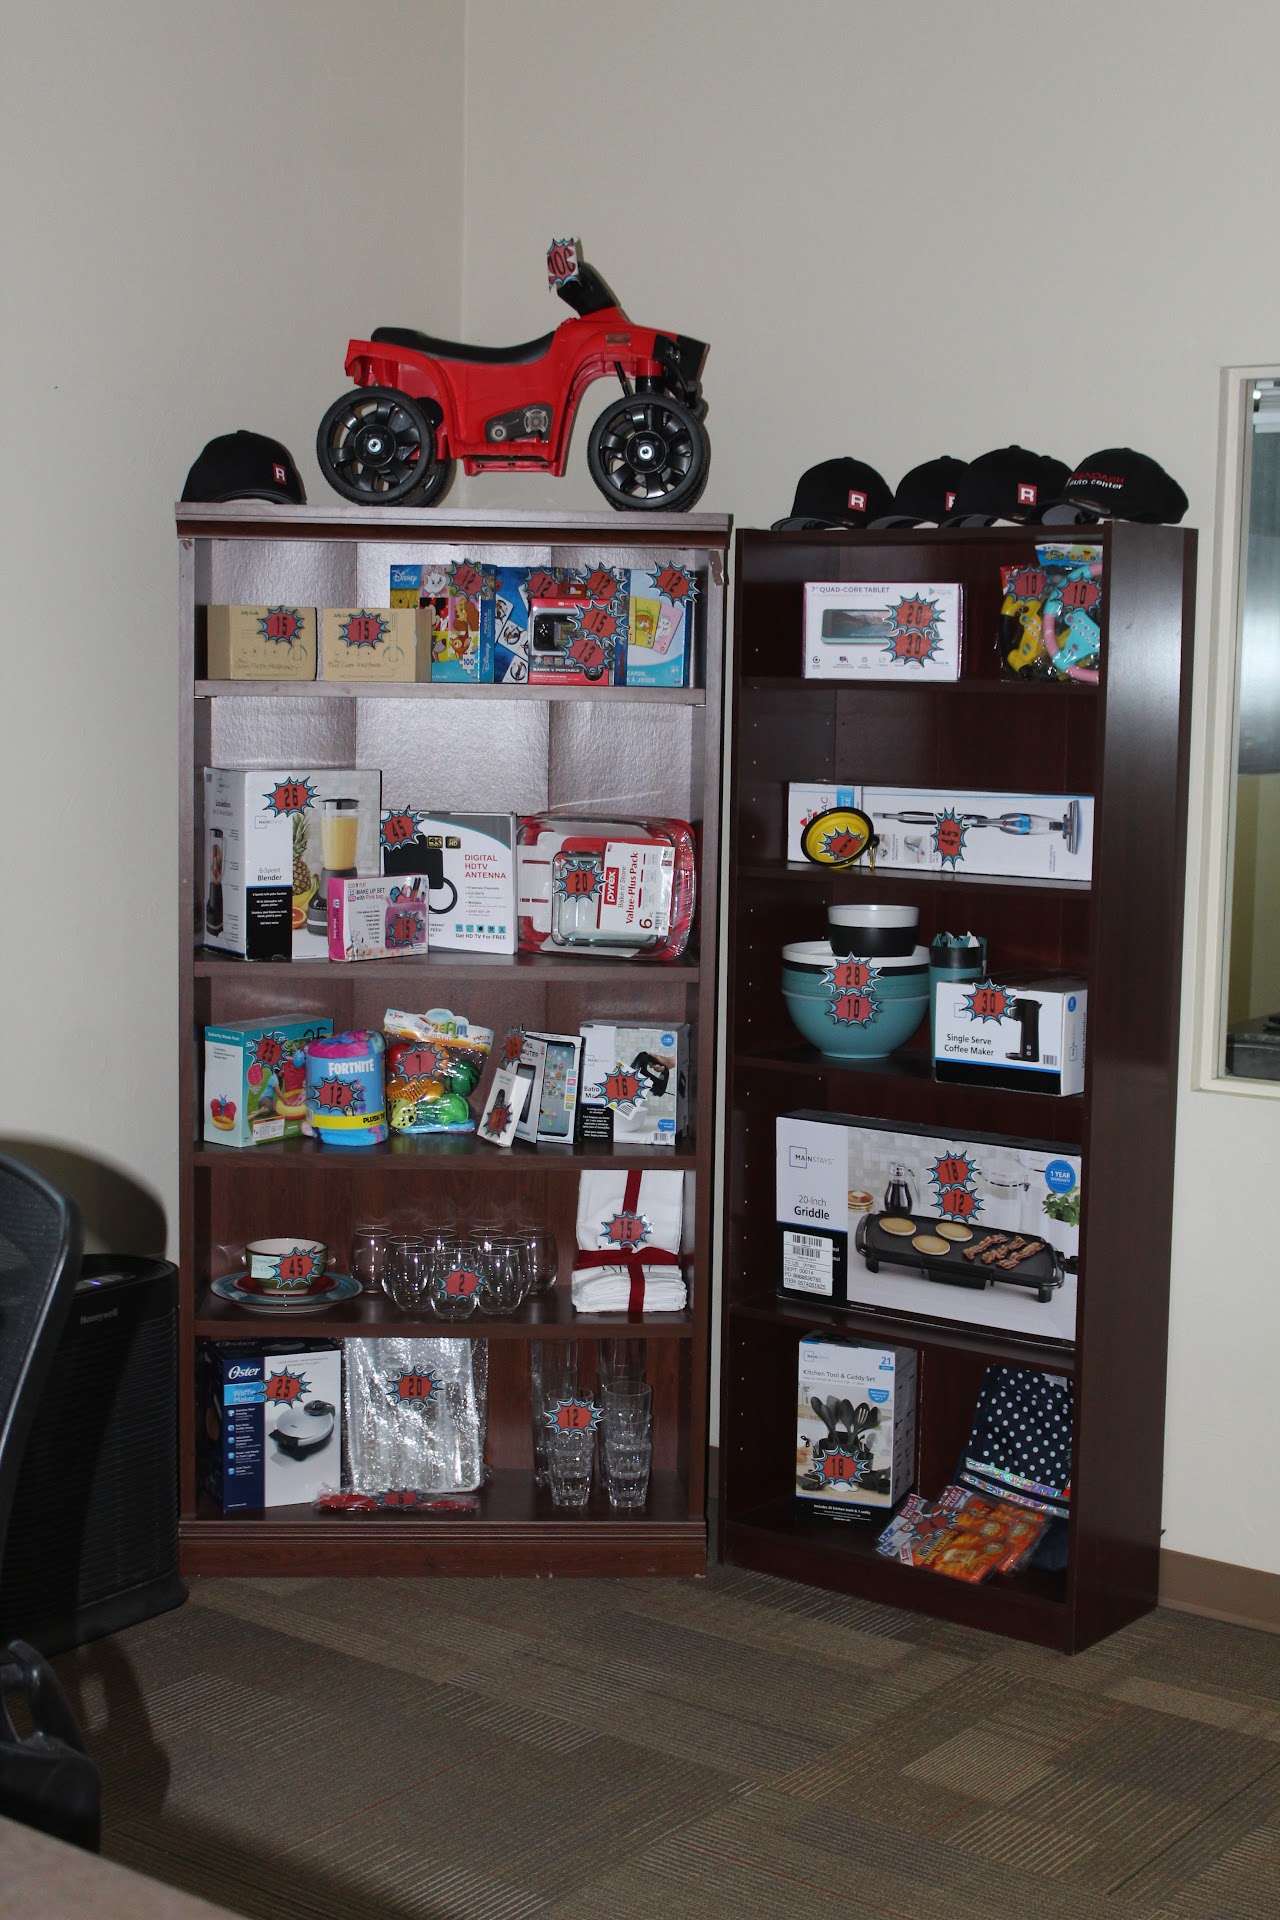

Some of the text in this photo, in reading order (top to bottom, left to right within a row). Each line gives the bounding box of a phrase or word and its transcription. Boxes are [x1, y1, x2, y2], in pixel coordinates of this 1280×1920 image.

[276, 467, 286, 481] R
[1091, 480, 1124, 490] center
[851, 494, 865, 508] R
[1020, 487, 1034, 502] R
[392, 570, 417, 584] Disney
[665, 572, 682, 593] 12
[1026, 575, 1037, 595] 10
[1074, 585, 1087, 605] 10
[590, 613, 608, 632] 15
[906, 605, 923, 625] 20
[276, 616, 288, 635] 15
[357, 620, 369, 640] 15
[578, 642, 596, 662] 13
[906, 634, 921, 654] 30
[284, 788, 299, 807] 26
[392, 820, 407, 839] 45
[941, 831, 959, 846] 45
[464, 854, 498, 862] DIGITAL
[465, 871, 507, 879] ANTENNA
[575, 873, 588, 892] 20
[607, 870, 617, 903] pyrex
[626, 852, 639, 924] Value-Plus Pack
[639, 918, 653, 929] 6
[846, 965, 860, 985] 28
[847, 999, 860, 1018] 10
[982, 993, 996, 1013] 30
[946, 1034, 992, 1045] Single Serve
[944, 1045, 994, 1056] Coffee Maker
[328, 1058, 375, 1076] FORTNITE
[330, 1087, 342, 1104] 12
[615, 1078, 628, 1096] 16
[363, 1113, 377, 1124] PLUSH
[795, 1154, 832, 1165] MAINSTAYS
[1055, 1171, 1071, 1179] YEAR
[798, 1195, 827, 1206] 20-Inch
[953, 1193, 965, 1213] 12
[794, 1205, 830, 1220] Griddle
[620, 1221, 632, 1239] 15
[289, 1259, 303, 1277] 45
[458, 1274, 465, 1292] 2
[881, 1357, 891, 1365] 21
[228, 1365, 261, 1380] Oster
[846, 1374, 864, 1382] Caddy
[233, 1388, 256, 1397] Waffle
[276, 1379, 290, 1398] 25
[408, 1378, 422, 1396] 20
[566, 1409, 579, 1427] 12
[832, 1458, 843, 1476] 18
[900, 1498, 914, 1517] GREAT
